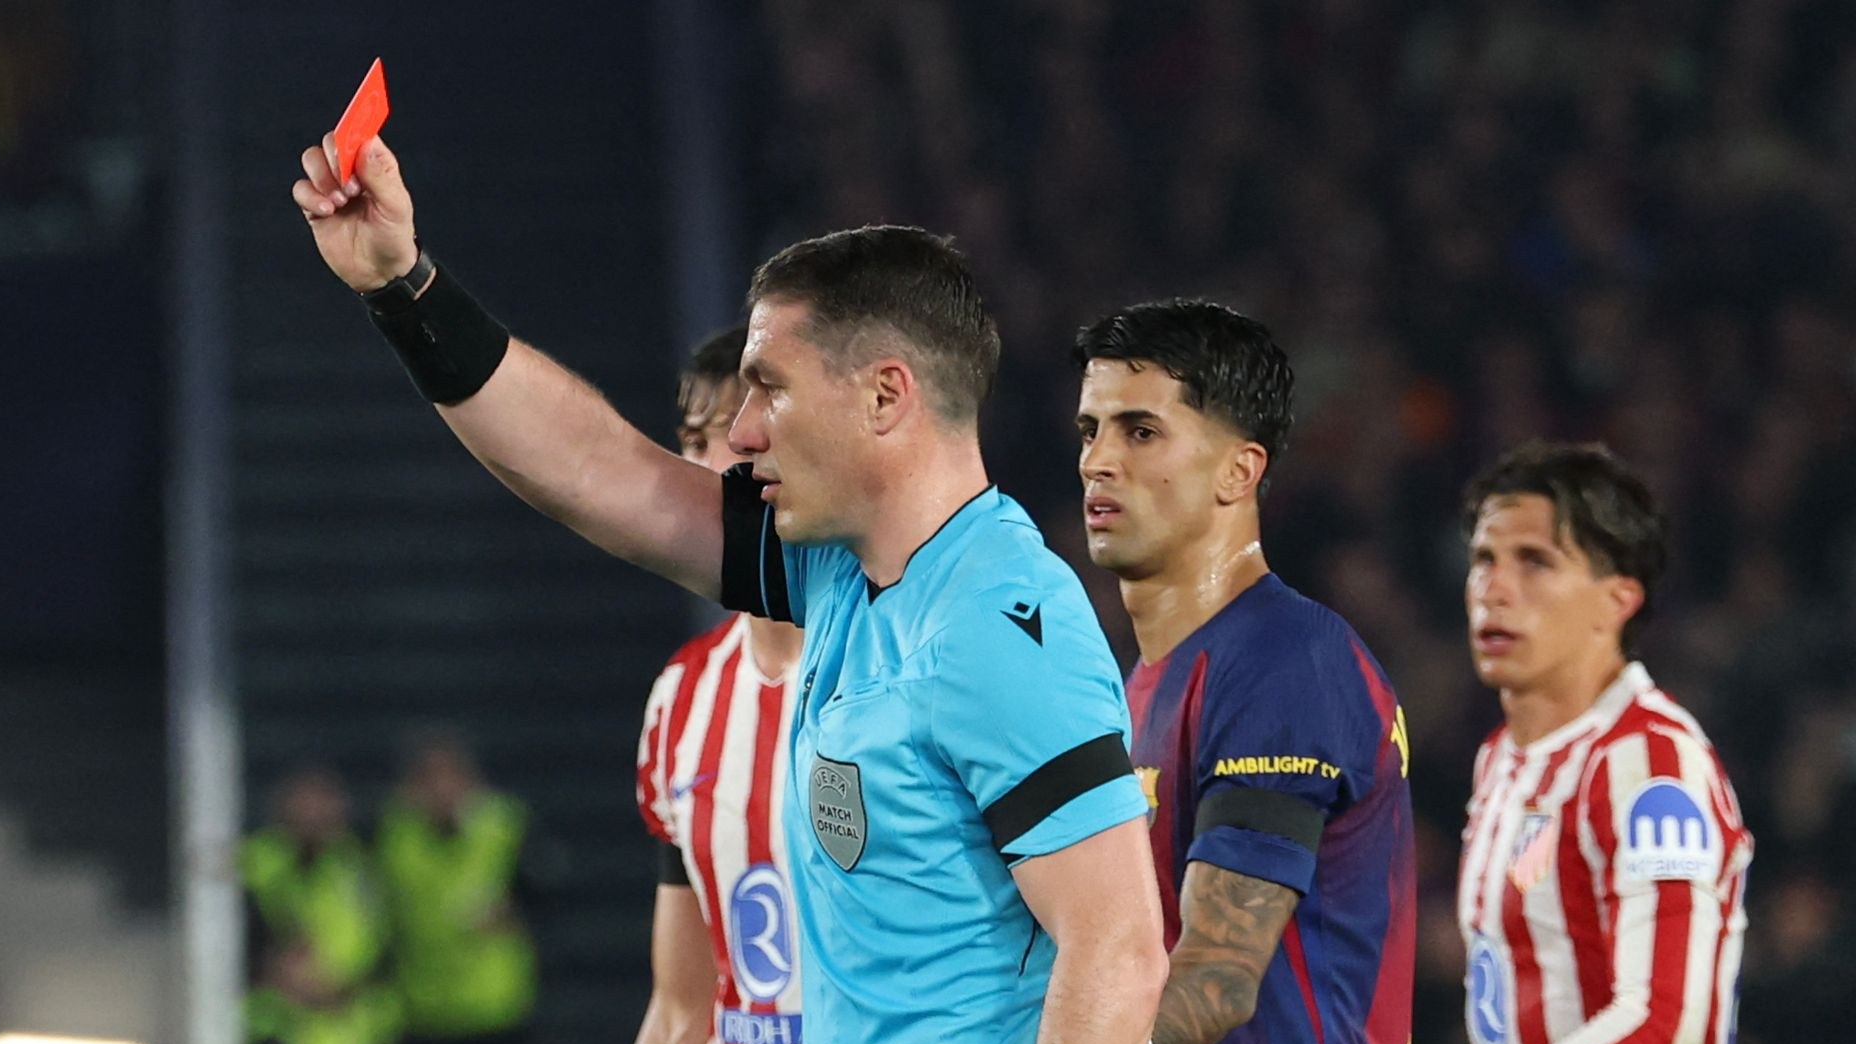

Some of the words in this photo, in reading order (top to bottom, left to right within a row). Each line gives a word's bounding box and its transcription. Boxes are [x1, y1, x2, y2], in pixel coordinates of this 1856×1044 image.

[1214, 756, 1319, 776] AMBILIGHT
[1320, 762, 1341, 779] tv
[814, 769, 849, 800] UEFA
[817, 801, 853, 822] MATCH
[816, 819, 860, 840] OFFICIAL
